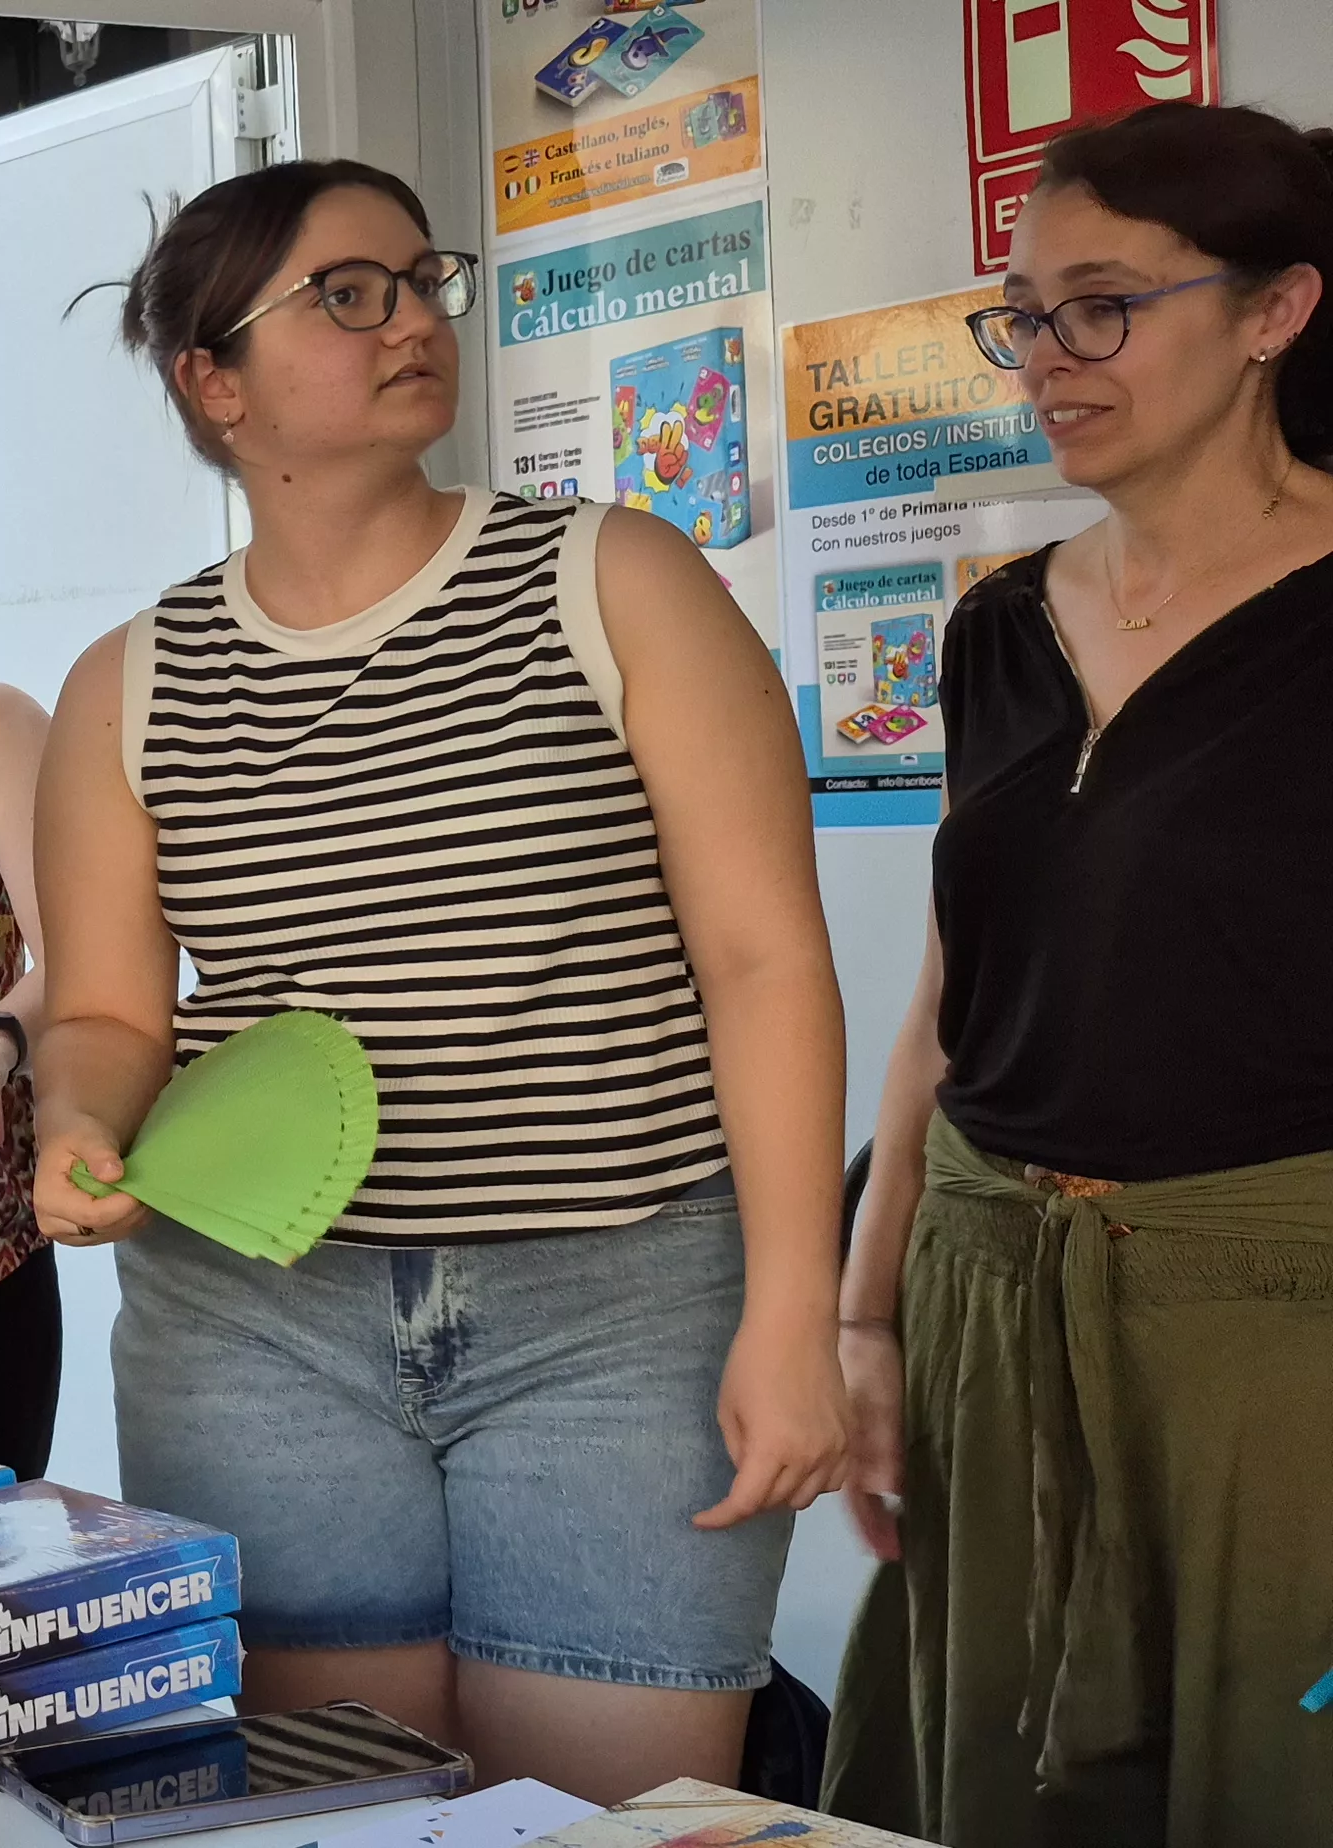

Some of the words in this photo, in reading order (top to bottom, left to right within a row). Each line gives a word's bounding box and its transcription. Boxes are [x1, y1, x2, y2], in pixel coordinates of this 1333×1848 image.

[544, 130, 620, 161] Castellano,
[623, 114, 670, 137] Inglés,
[549, 161, 601, 185] Francés
[604, 159, 613, 170] e
[616, 144, 670, 167] Italiano
[542, 261, 617, 297] Juego
[626, 249, 656, 275] de
[665, 227, 752, 266] cartas
[511, 291, 627, 341] Cálculo
[635, 258, 751, 316] mental
[806, 342, 946, 393] TALLER
[809, 373, 997, 431] GRATUITO
[513, 454, 536, 475] 131
[813, 430, 927, 464] COLEGIOS
[865, 466, 890, 486] de
[897, 461, 942, 482] toda
[949, 446, 1030, 474] España
[812, 512, 856, 530] Desde
[879, 505, 897, 521] de
[902, 501, 968, 518] Primaria
[812, 537, 840, 553] Con
[845, 529, 907, 549] nuestros
[910, 523, 961, 544] juegos
[821, 592, 880, 611] Cálculo
[883, 586, 937, 605] mental
[837, 578, 875, 594] Juego
[877, 575, 893, 588] de
[896, 572, 937, 586] cartas
